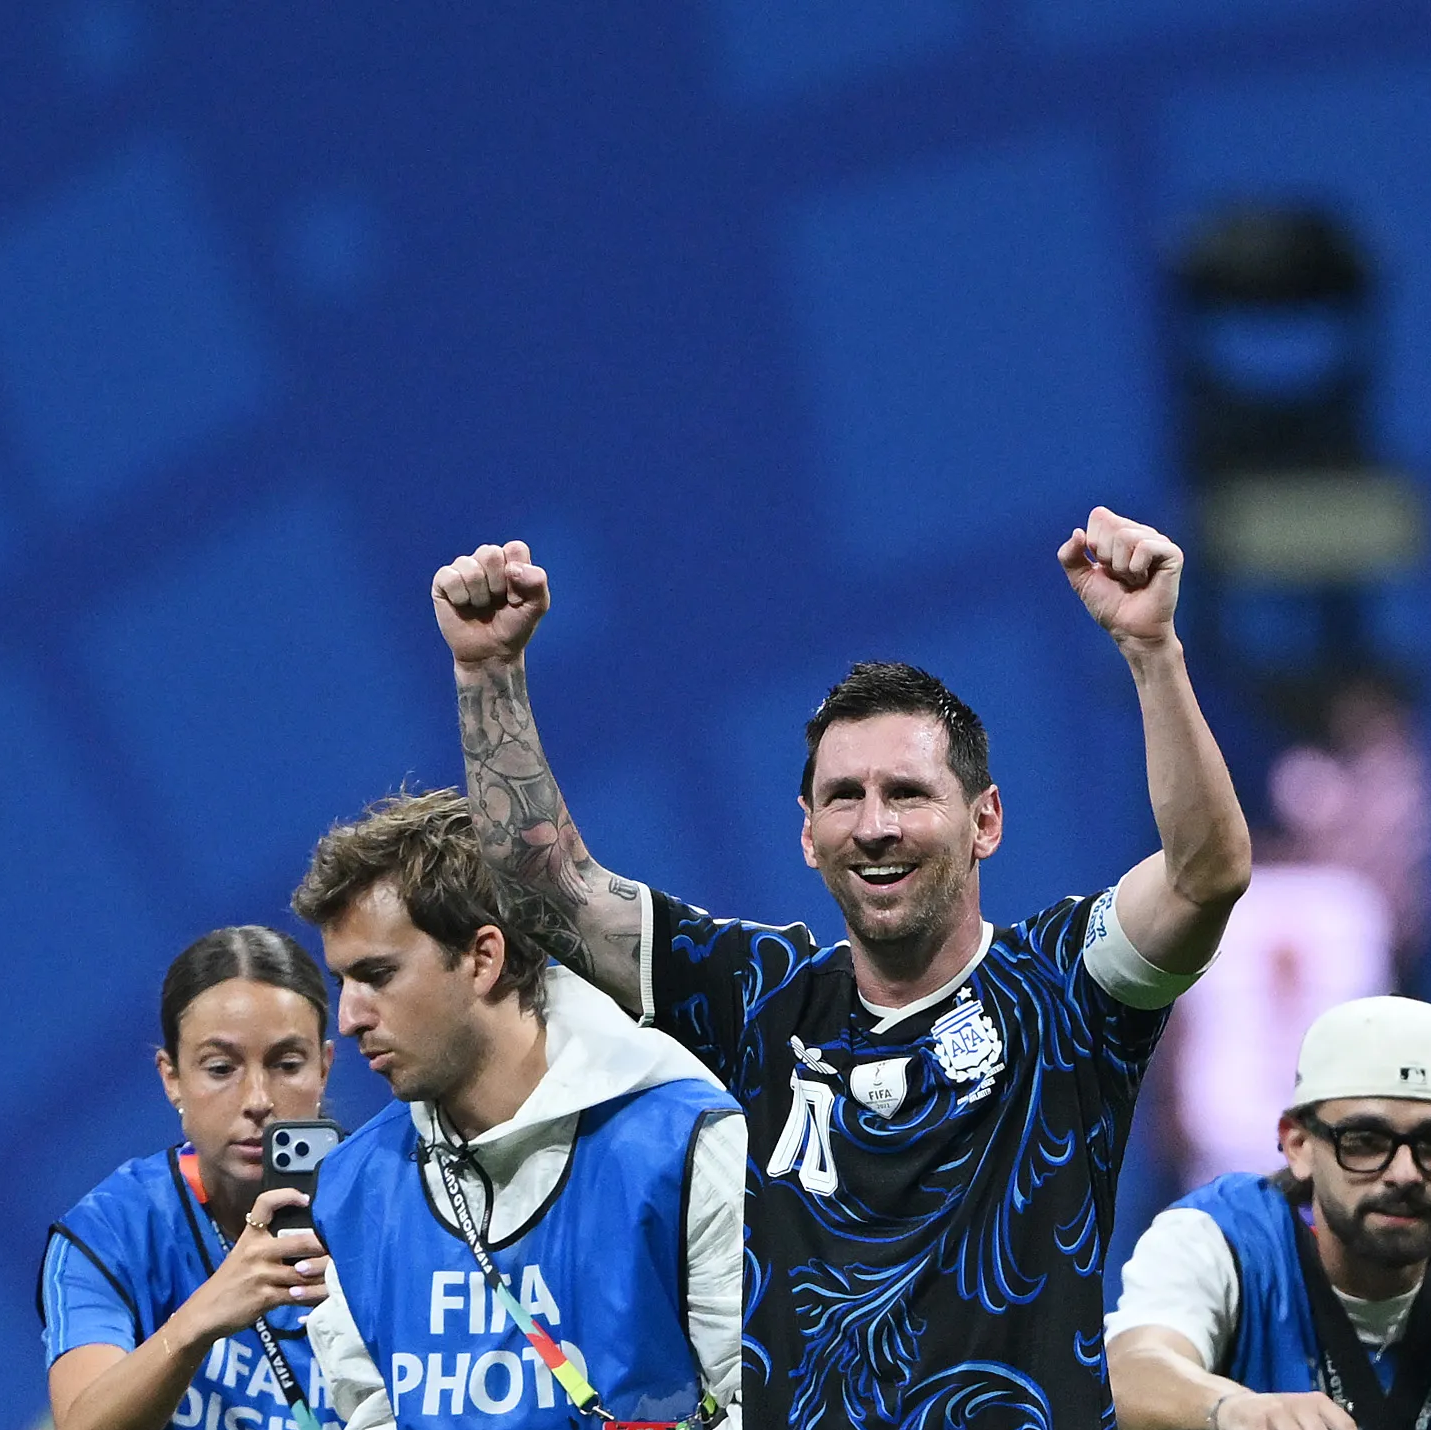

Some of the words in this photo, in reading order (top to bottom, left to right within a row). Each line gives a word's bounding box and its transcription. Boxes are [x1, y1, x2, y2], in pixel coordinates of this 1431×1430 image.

[949, 1021, 986, 1059] AFA
[868, 1088, 893, 1101] FIFA
[453, 1193, 478, 1247] WORLD
[473, 1240, 494, 1275] FIFA
[429, 1264, 561, 1335] FIFA
[205, 1337, 289, 1406] IFA
[272, 1355, 295, 1390] FIFA
[391, 1339, 589, 1417] PHOTO
